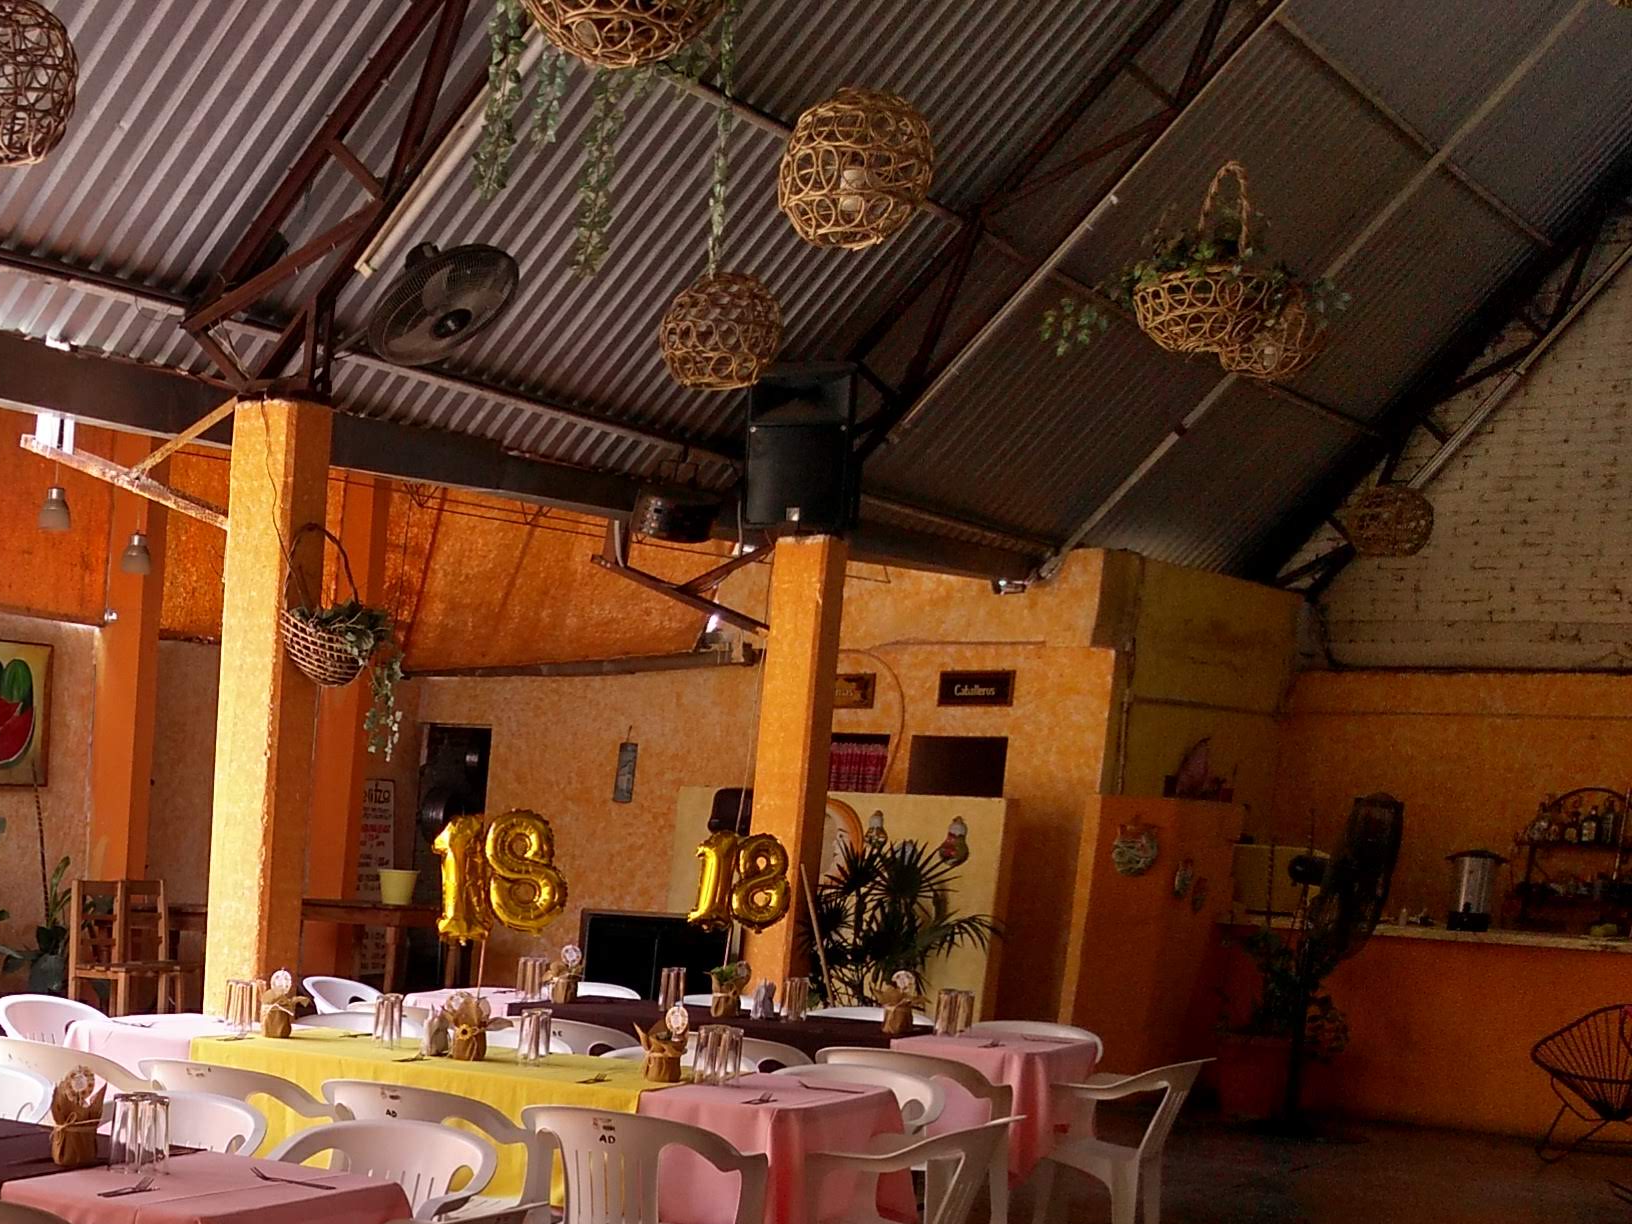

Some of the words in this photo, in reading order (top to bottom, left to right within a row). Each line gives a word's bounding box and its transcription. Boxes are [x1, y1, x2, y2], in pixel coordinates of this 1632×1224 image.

[954, 684, 995, 696] Caballeros
[433, 808, 568, 944] 18
[687, 830, 791, 933] 18
[599, 1134, 617, 1144] AD
